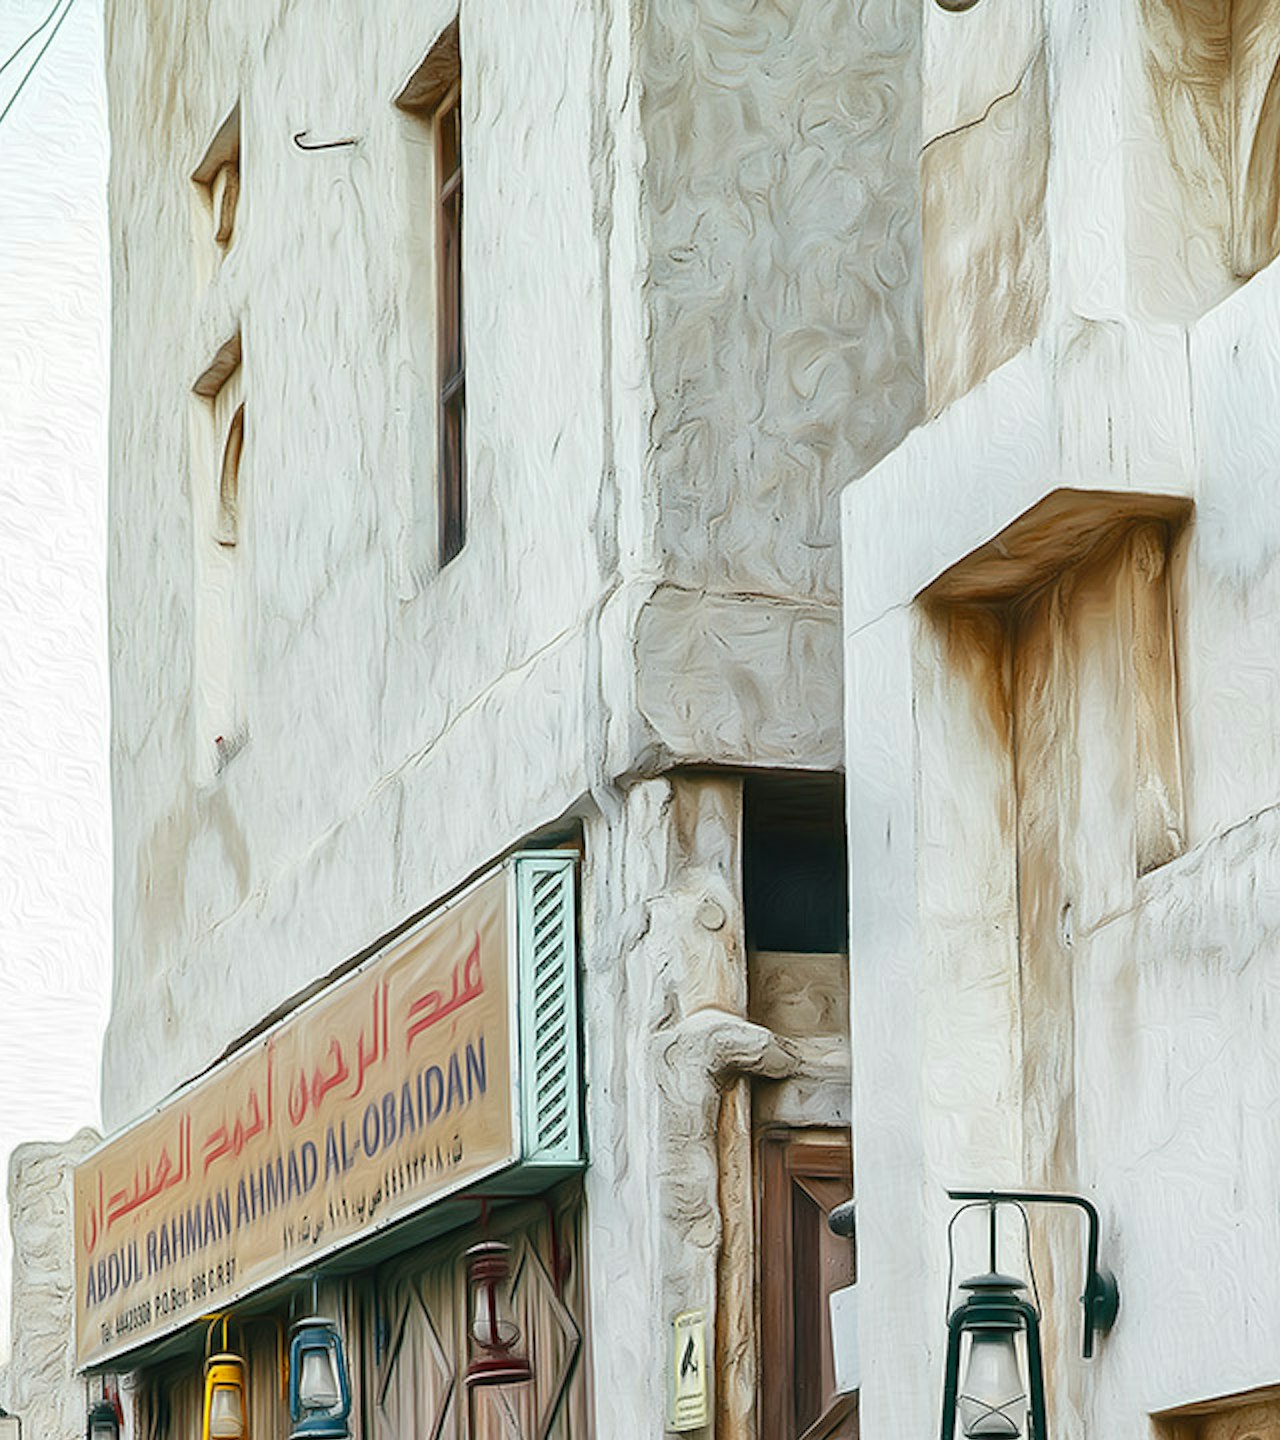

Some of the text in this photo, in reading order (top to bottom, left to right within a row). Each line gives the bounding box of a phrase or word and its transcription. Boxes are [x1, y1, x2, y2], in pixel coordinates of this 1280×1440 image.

[288, 978, 389, 1127] الرحمن
[406, 930, 485, 1052] عبد
[86, 1035, 486, 1308] ABDUL RAHMAN AHMAD AL-OBAIDAN
[201, 1034, 274, 1178] أحمد
